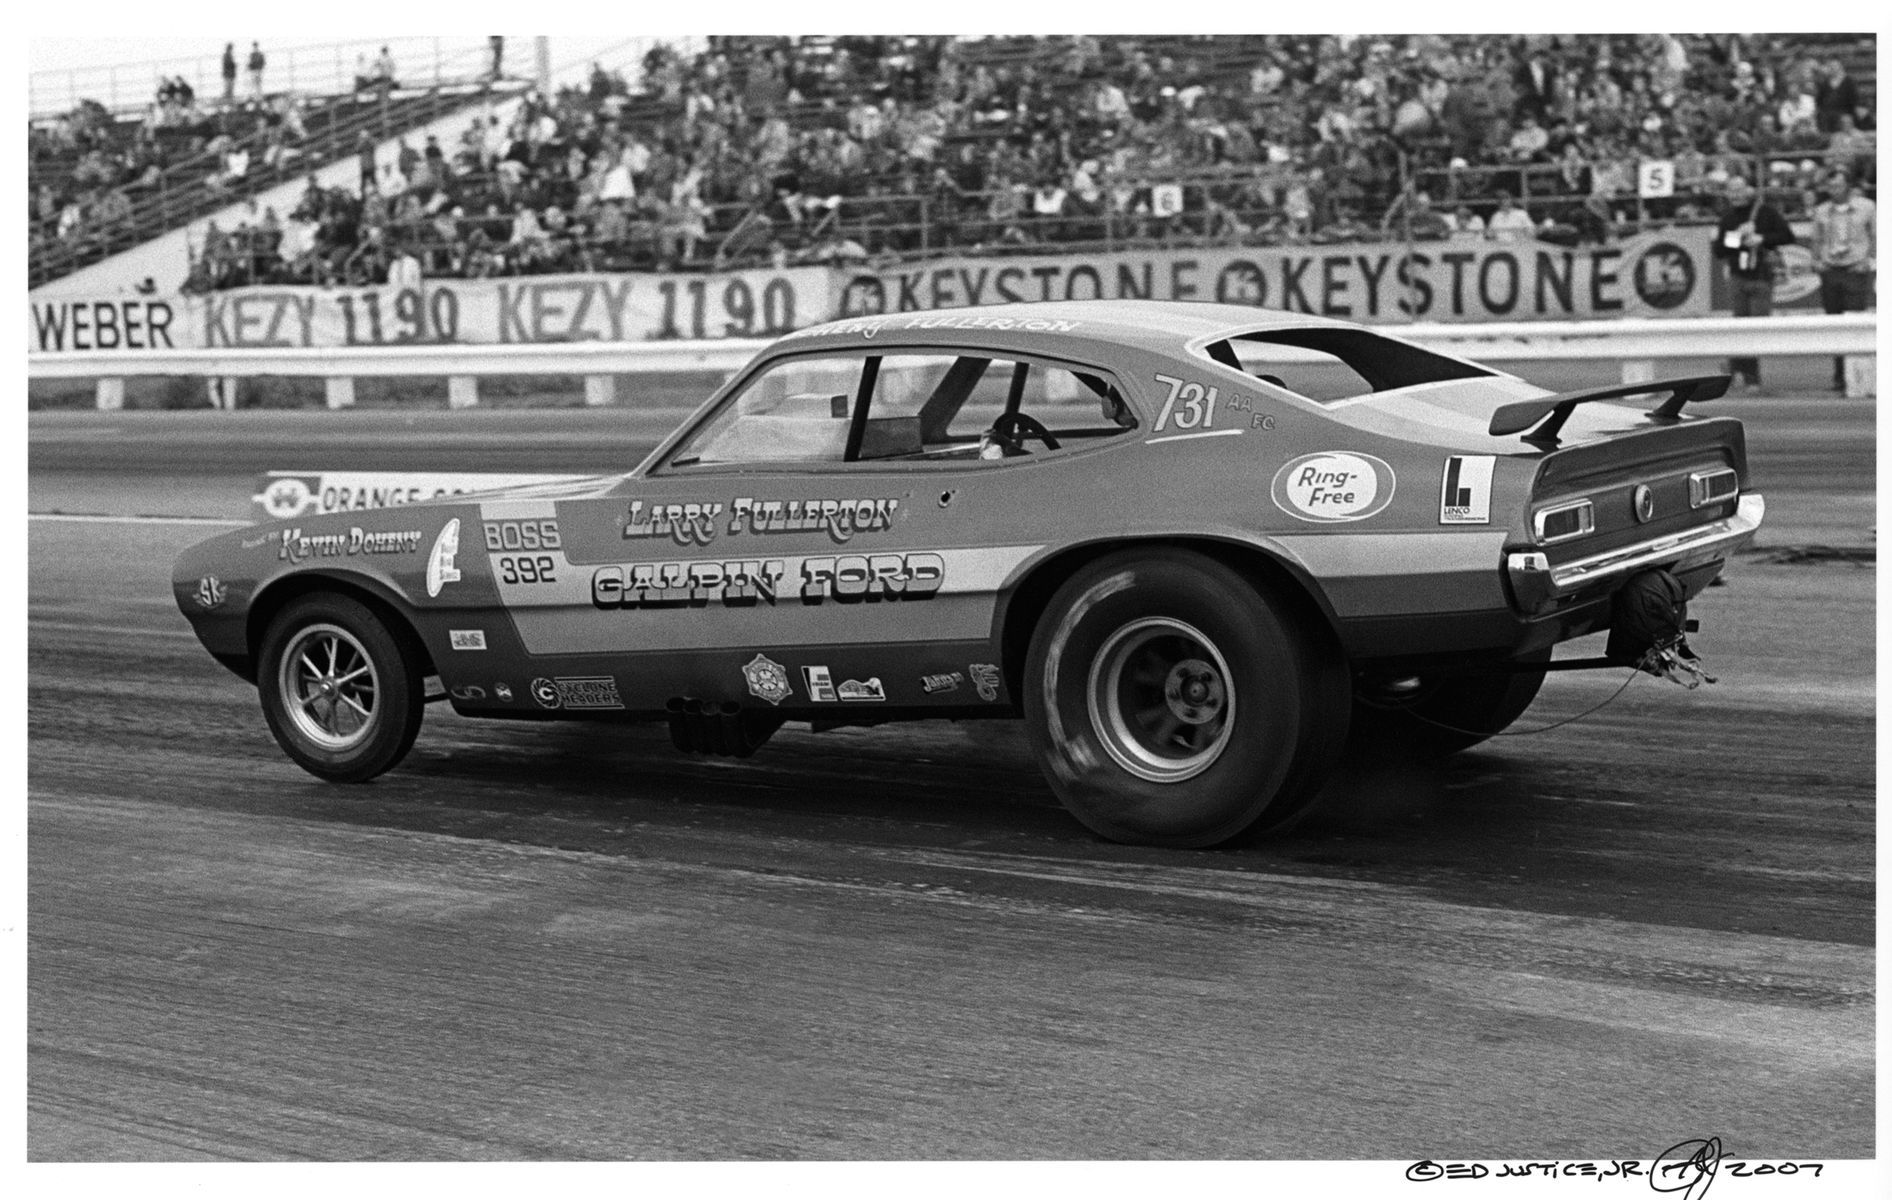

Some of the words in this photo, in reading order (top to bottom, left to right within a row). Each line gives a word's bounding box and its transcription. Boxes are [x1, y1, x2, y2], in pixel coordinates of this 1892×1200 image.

[1649, 169, 1663, 189] 5
[1161, 191, 1175, 210] 6
[900, 260, 1198, 314] KEYSTONE
[1281, 251, 1622, 316] KEYSTONE
[33, 302, 175, 351] WEBER
[205, 293, 316, 347] KEZY
[338, 287, 459, 346] 1190
[499, 280, 635, 343] KEZY
[1152, 372, 1219, 433] 731
[1225, 393, 1252, 412] AA
[1298, 467, 1358, 489] Ring-
[322, 486, 420, 512] ORANGE
[1309, 487, 1356, 507] Free
[1444, 507, 1470, 515] LENCO
[485, 519, 562, 552] BOSS
[623, 500, 723, 544] LARRY
[728, 498, 898, 544] FULLERTON
[279, 528, 346, 564] KEVIN
[348, 527, 422, 557] DOHENY
[502, 555, 558, 584] 392
[592, 558, 786, 609] GALPIN
[799, 552, 945, 606] FORD
